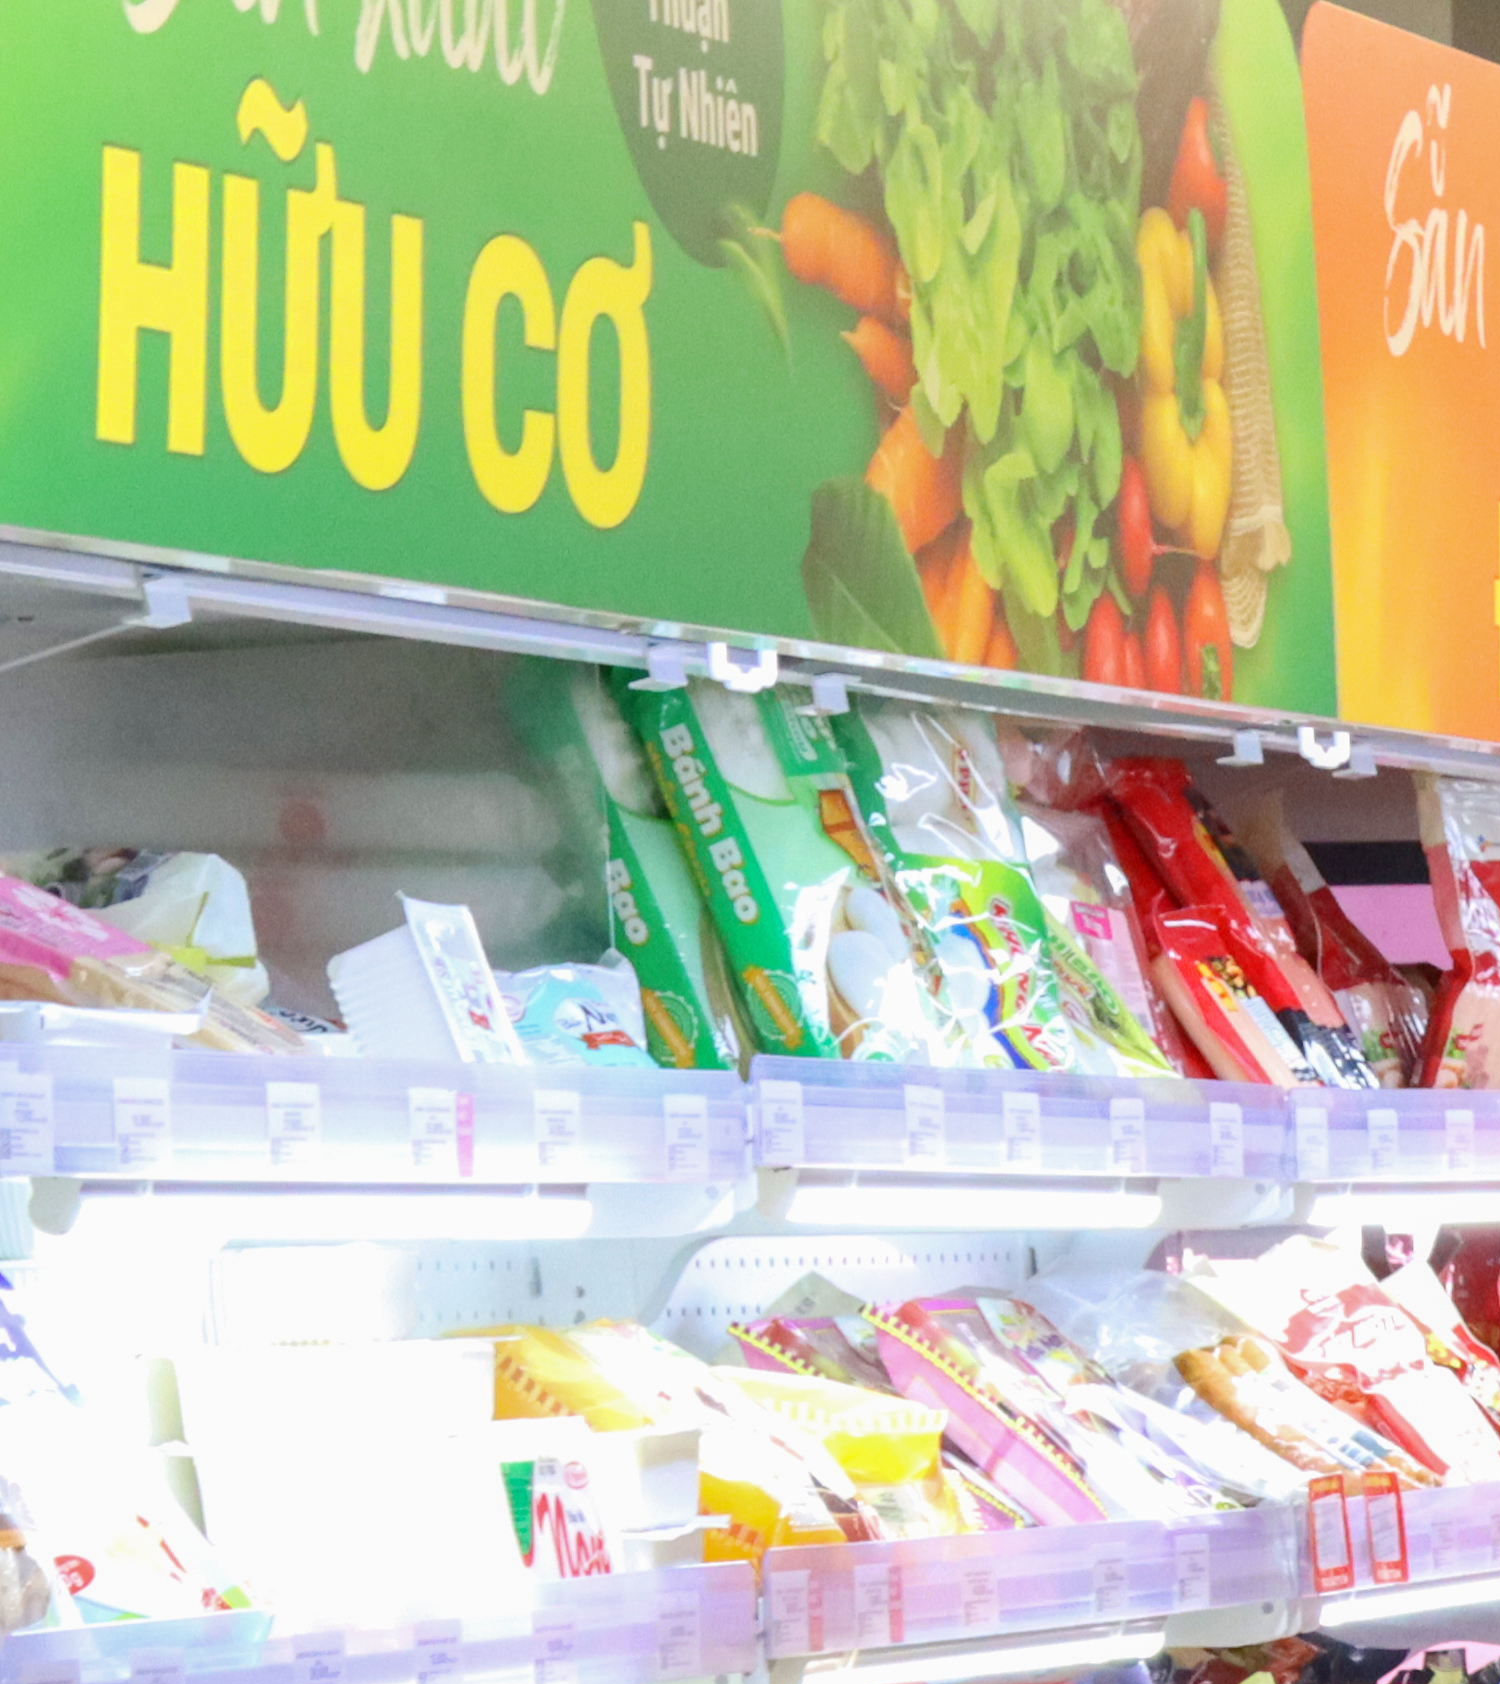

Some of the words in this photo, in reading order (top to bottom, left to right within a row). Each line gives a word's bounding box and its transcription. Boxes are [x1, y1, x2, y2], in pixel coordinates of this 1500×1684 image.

[632, 54, 673, 150] Tự
[678, 67, 758, 157] Nhiên
[96, 76, 423, 491] HỮU
[461, 221, 652, 530] CƠ
[660, 722, 723, 838] Bánh
[708, 837, 759, 924] Bao
[606, 857, 649, 946] Bao
